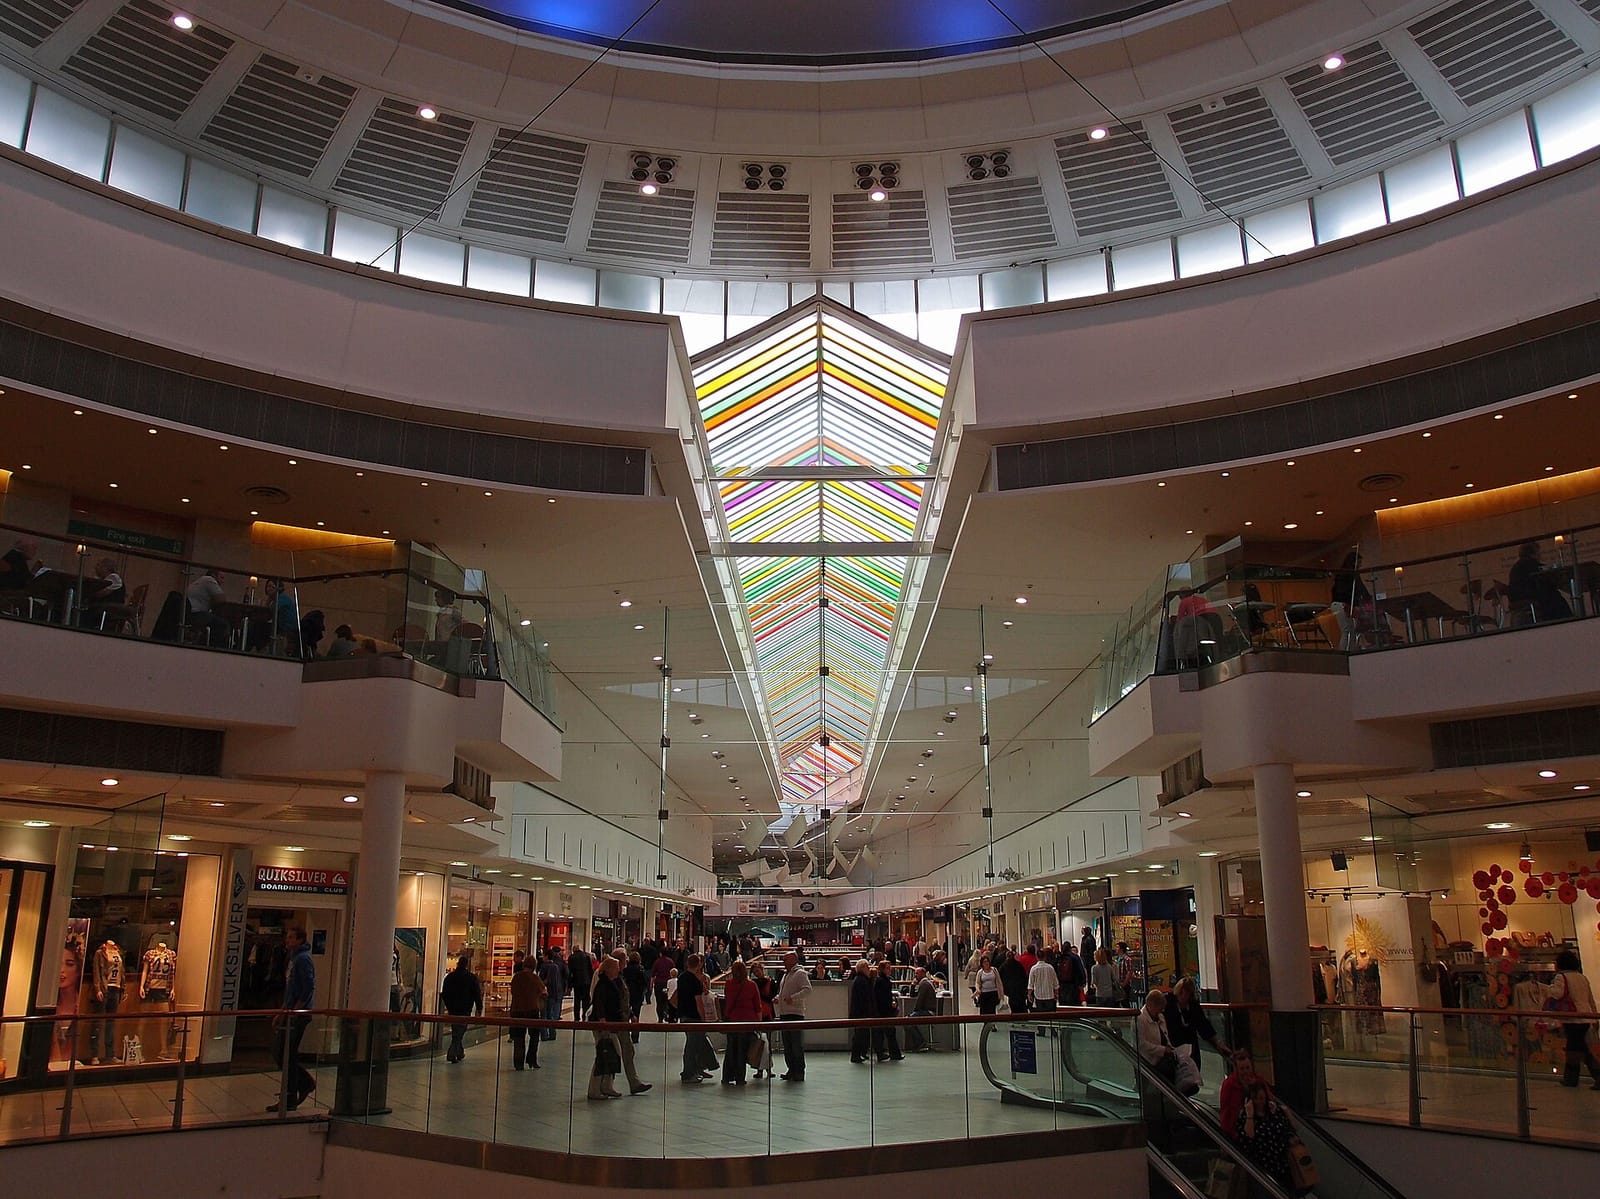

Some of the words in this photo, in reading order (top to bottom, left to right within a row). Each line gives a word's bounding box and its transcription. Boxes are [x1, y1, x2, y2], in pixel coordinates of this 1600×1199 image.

[107, 530, 125, 541] Fire
[127, 535, 145, 545] exit
[258, 868, 326, 883] QUIKSILVER
[260, 883, 318, 892] BOARDRIDERS
